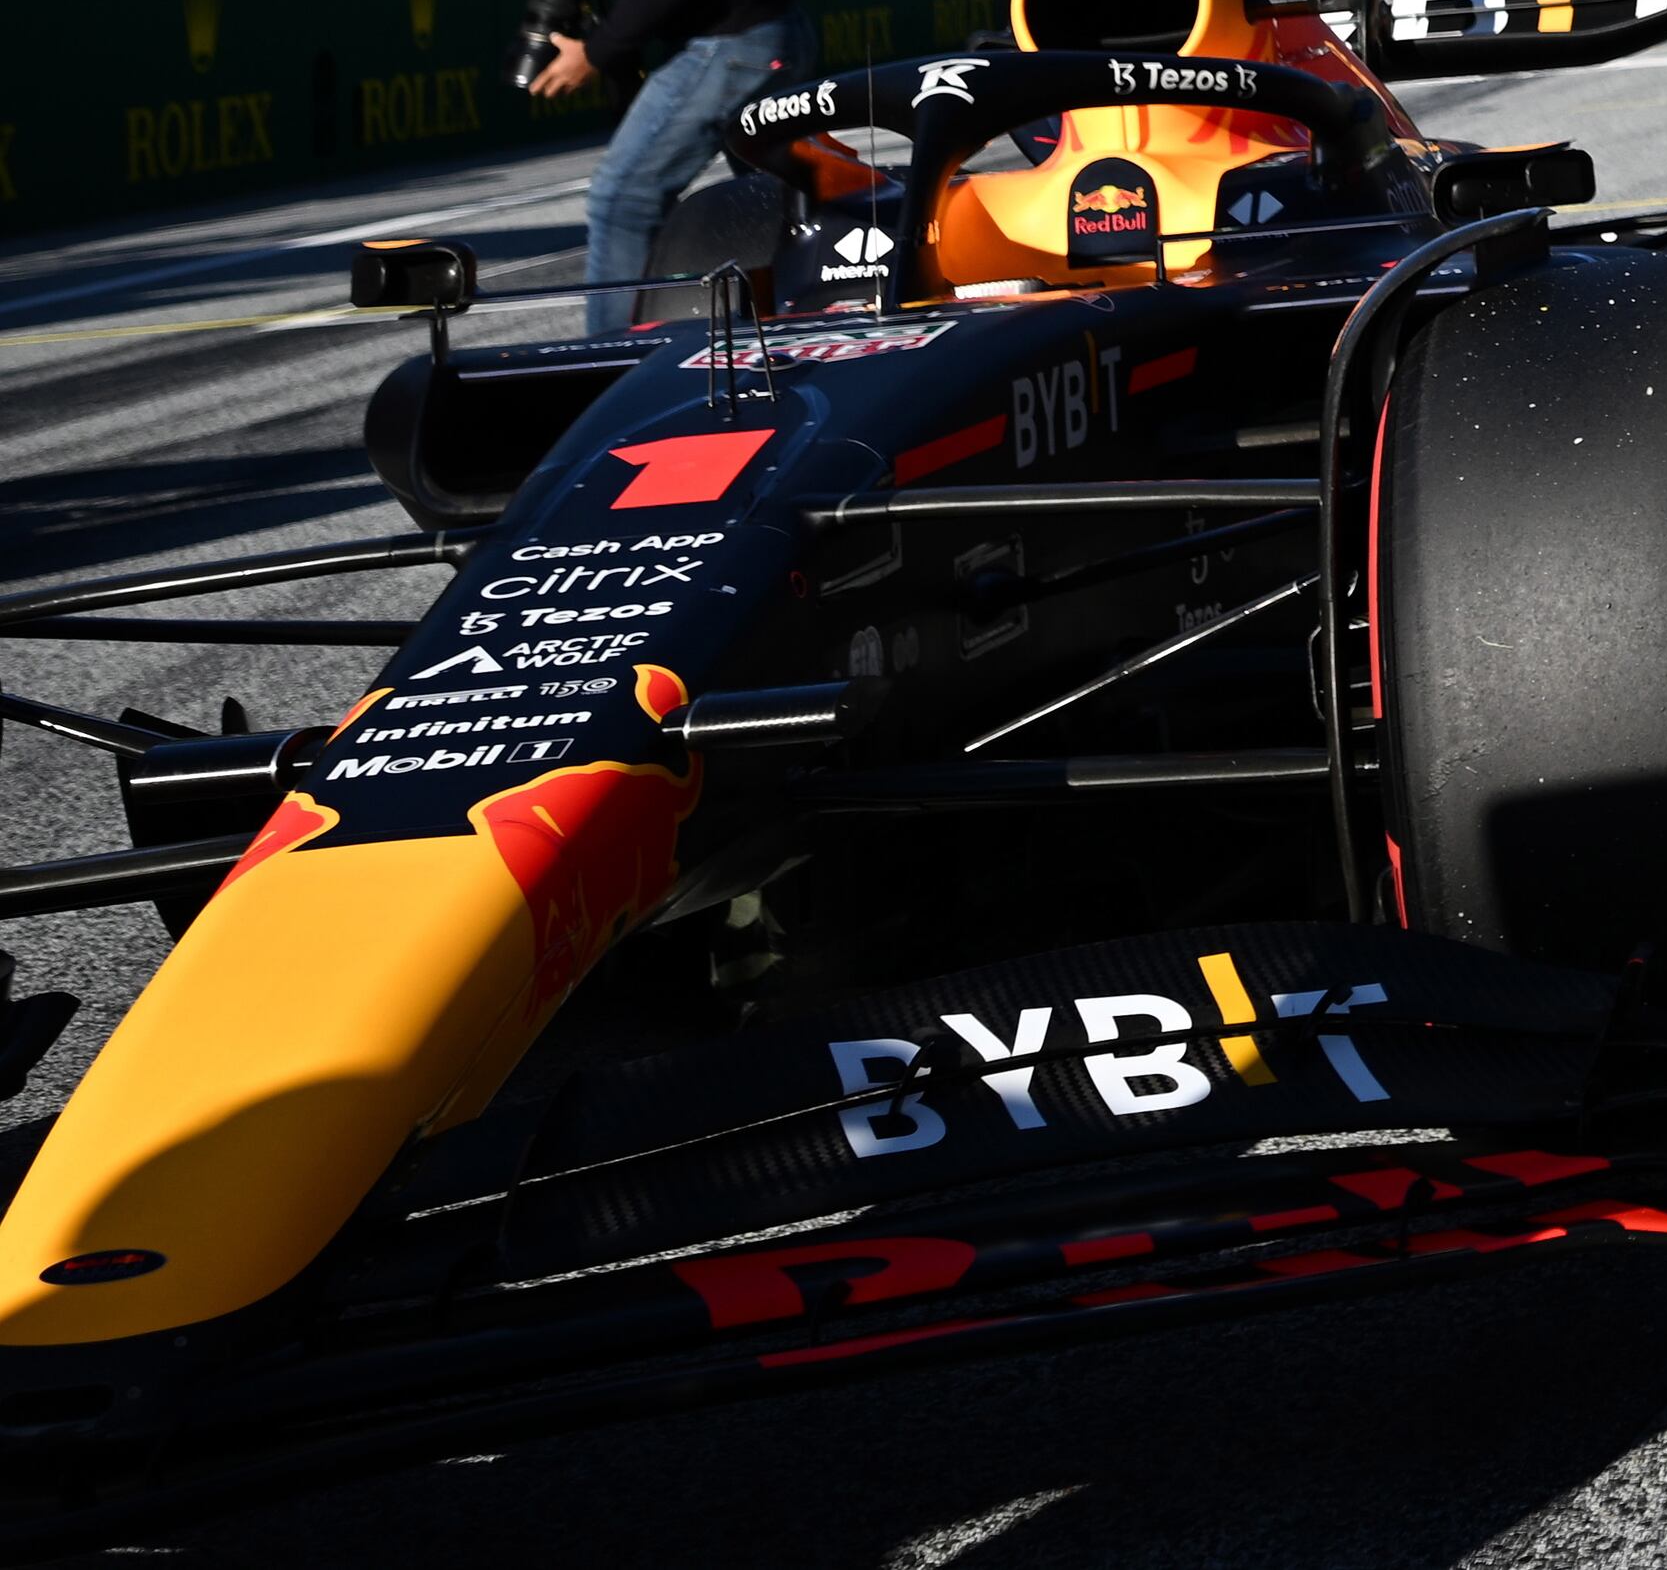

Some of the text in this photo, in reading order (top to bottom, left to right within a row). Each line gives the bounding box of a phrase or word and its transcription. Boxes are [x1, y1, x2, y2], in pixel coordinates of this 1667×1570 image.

[1143, 61, 1229, 93] Tezos
[361, 68, 481, 145] ROLEX
[127, 92, 273, 184] ROLEX
[1075, 210, 1147, 236] Red Bull
[1012, 343, 1123, 469] BYBIT
[608, 429, 776, 510] 1
[511, 532, 725, 561] Cash App
[520, 601, 674, 628] Tezos
[502, 632, 650, 657] ARCTIC
[516, 647, 628, 669] WOLF
[384, 685, 529, 710] PIRELLI
[325, 744, 507, 782] Mobil
[828, 952, 1391, 1158] BYBIT
